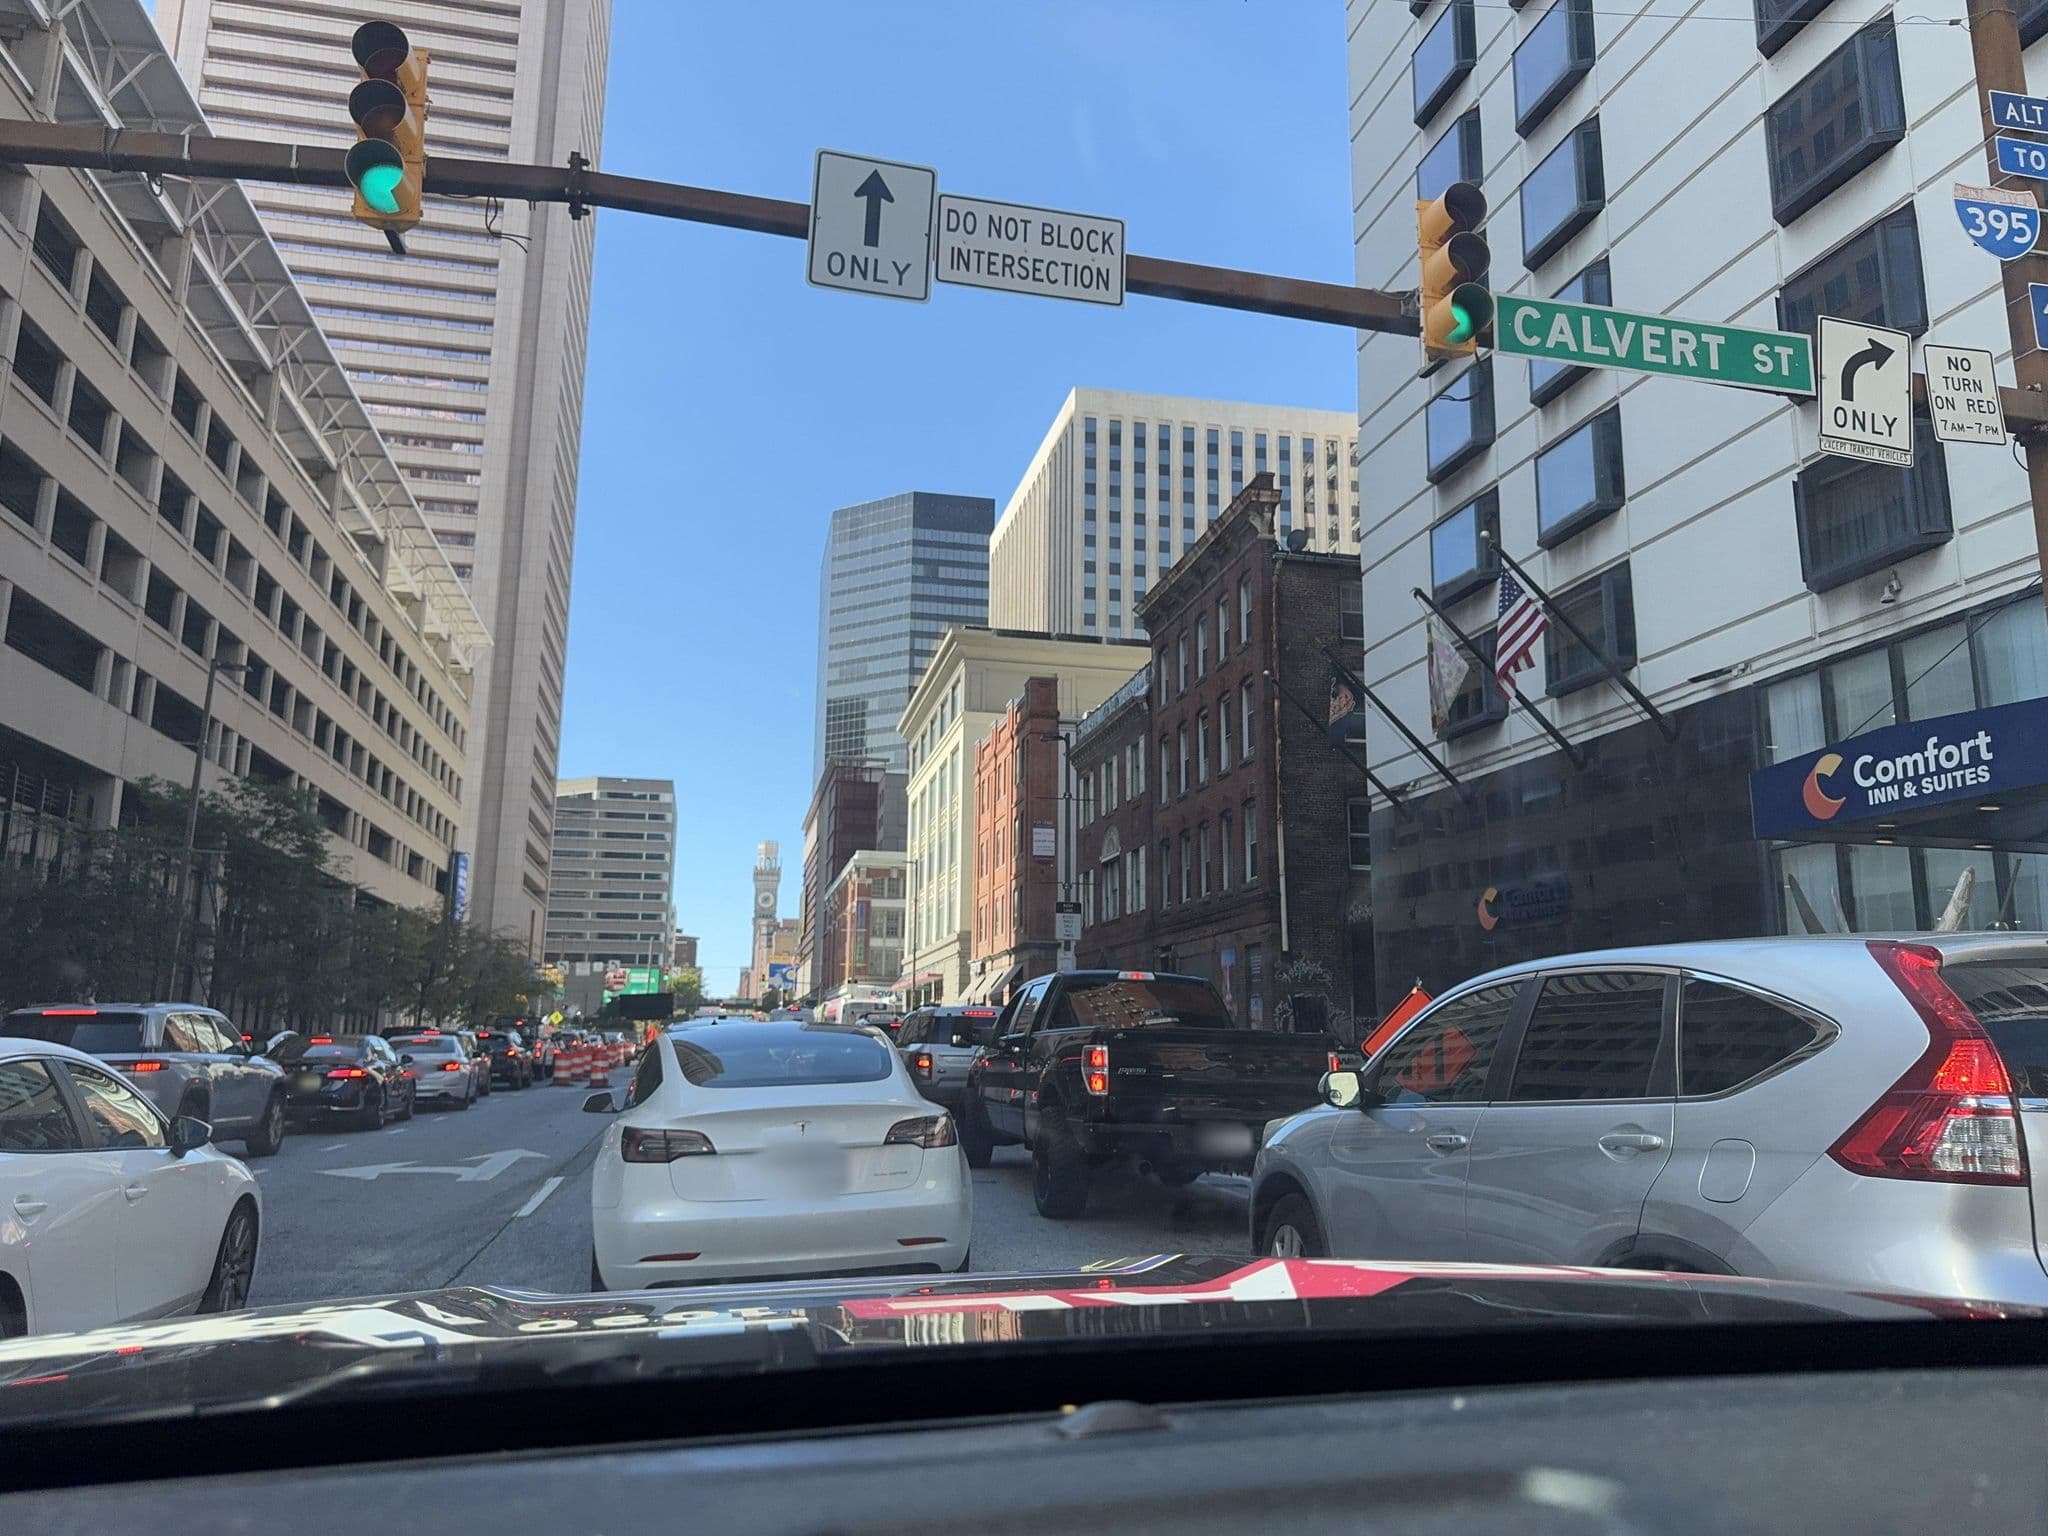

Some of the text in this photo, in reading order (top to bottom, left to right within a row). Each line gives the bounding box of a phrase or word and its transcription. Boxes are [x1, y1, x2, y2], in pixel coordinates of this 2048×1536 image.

[2006, 102, 2045, 125] ALT
[2013, 146, 2046, 171] TO
[946, 208, 1115, 256] DO NOT BLOCK
[1966, 206, 2032, 244] 395
[827, 252, 912, 286] ONLY
[950, 246, 1110, 292] INTERSECTION
[1514, 305, 1794, 376] CALVERT ST
[1947, 356, 1972, 372] NO
[1942, 376, 1983, 393] TURN
[1934, 395, 1997, 415] ON RED
[1834, 406, 1898, 438] ONLY
[1849, 442, 1875, 457] TRANSIT
[1877, 447, 1908, 463] VEHICLES
[1853, 730, 1993, 788] Comfort
[1868, 765, 1991, 806] INN & SUITES
